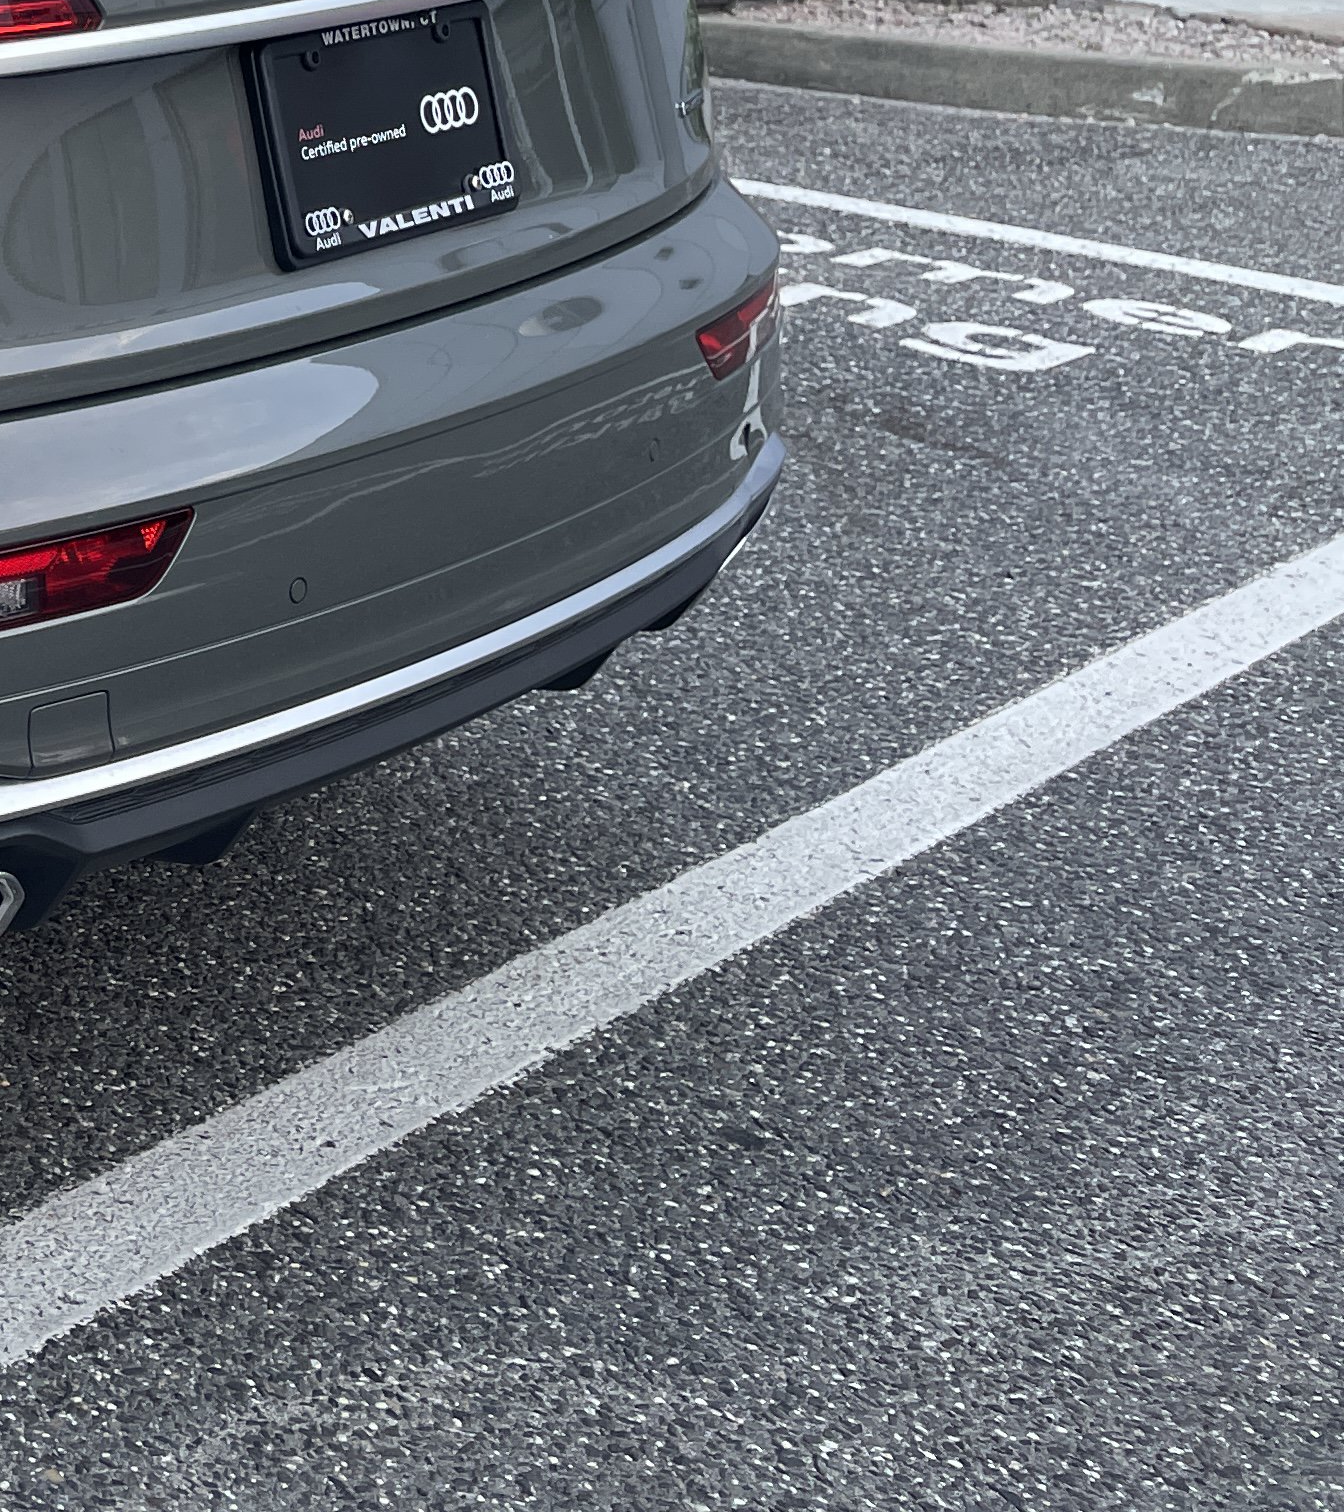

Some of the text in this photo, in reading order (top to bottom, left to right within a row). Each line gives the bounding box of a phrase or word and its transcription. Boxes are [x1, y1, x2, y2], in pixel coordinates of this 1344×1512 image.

[298, 123, 324, 142] Audi
[300, 124, 407, 161] Certified pre-owned
[491, 185, 515, 203] Audi
[358, 194, 475, 239] VALENTI
[316, 232, 342, 251] Audi
